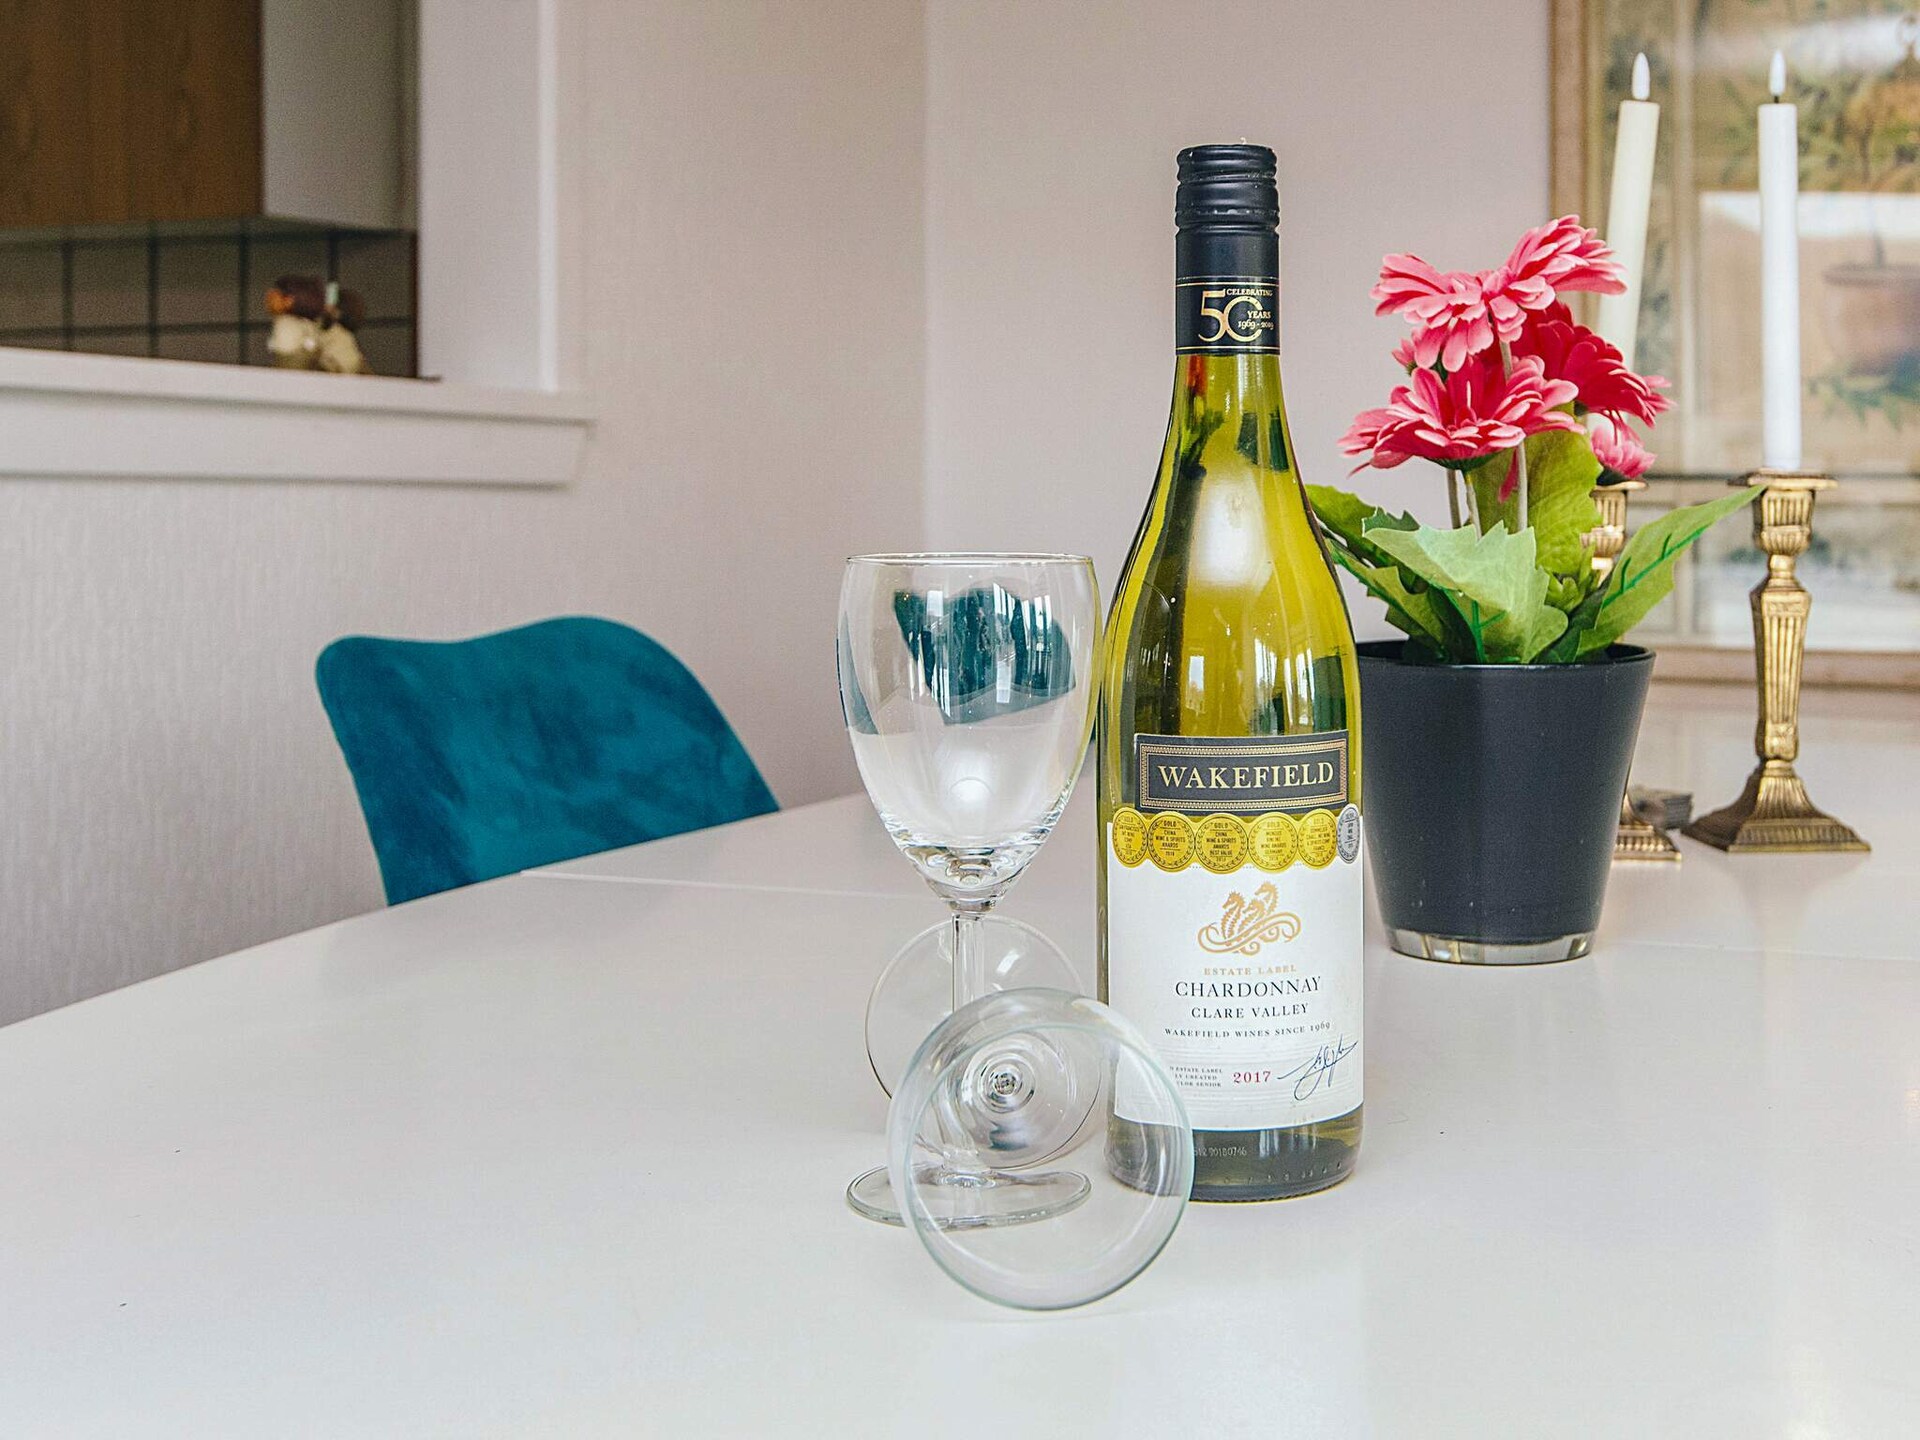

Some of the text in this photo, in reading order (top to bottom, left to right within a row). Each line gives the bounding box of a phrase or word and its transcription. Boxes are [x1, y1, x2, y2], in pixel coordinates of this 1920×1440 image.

[1226, 288, 1273, 296] CELEBRATING
[1198, 288, 1263, 342] 50
[1247, 310, 1272, 319] YEARS
[1157, 762, 1334, 789] WAKEFIELD
[1204, 964, 1297, 976] ESTATE LABEL
[1175, 976, 1321, 998] CHARDONNAY
[1191, 1003, 1308, 1019] CLARE VALLEY
[1164, 1028, 1230, 1038] WAKEFIELD
[1275, 1026, 1306, 1036] SINCE
[1310, 1021, 1331, 1032] 1969
[1233, 1070, 1271, 1084] 2017
